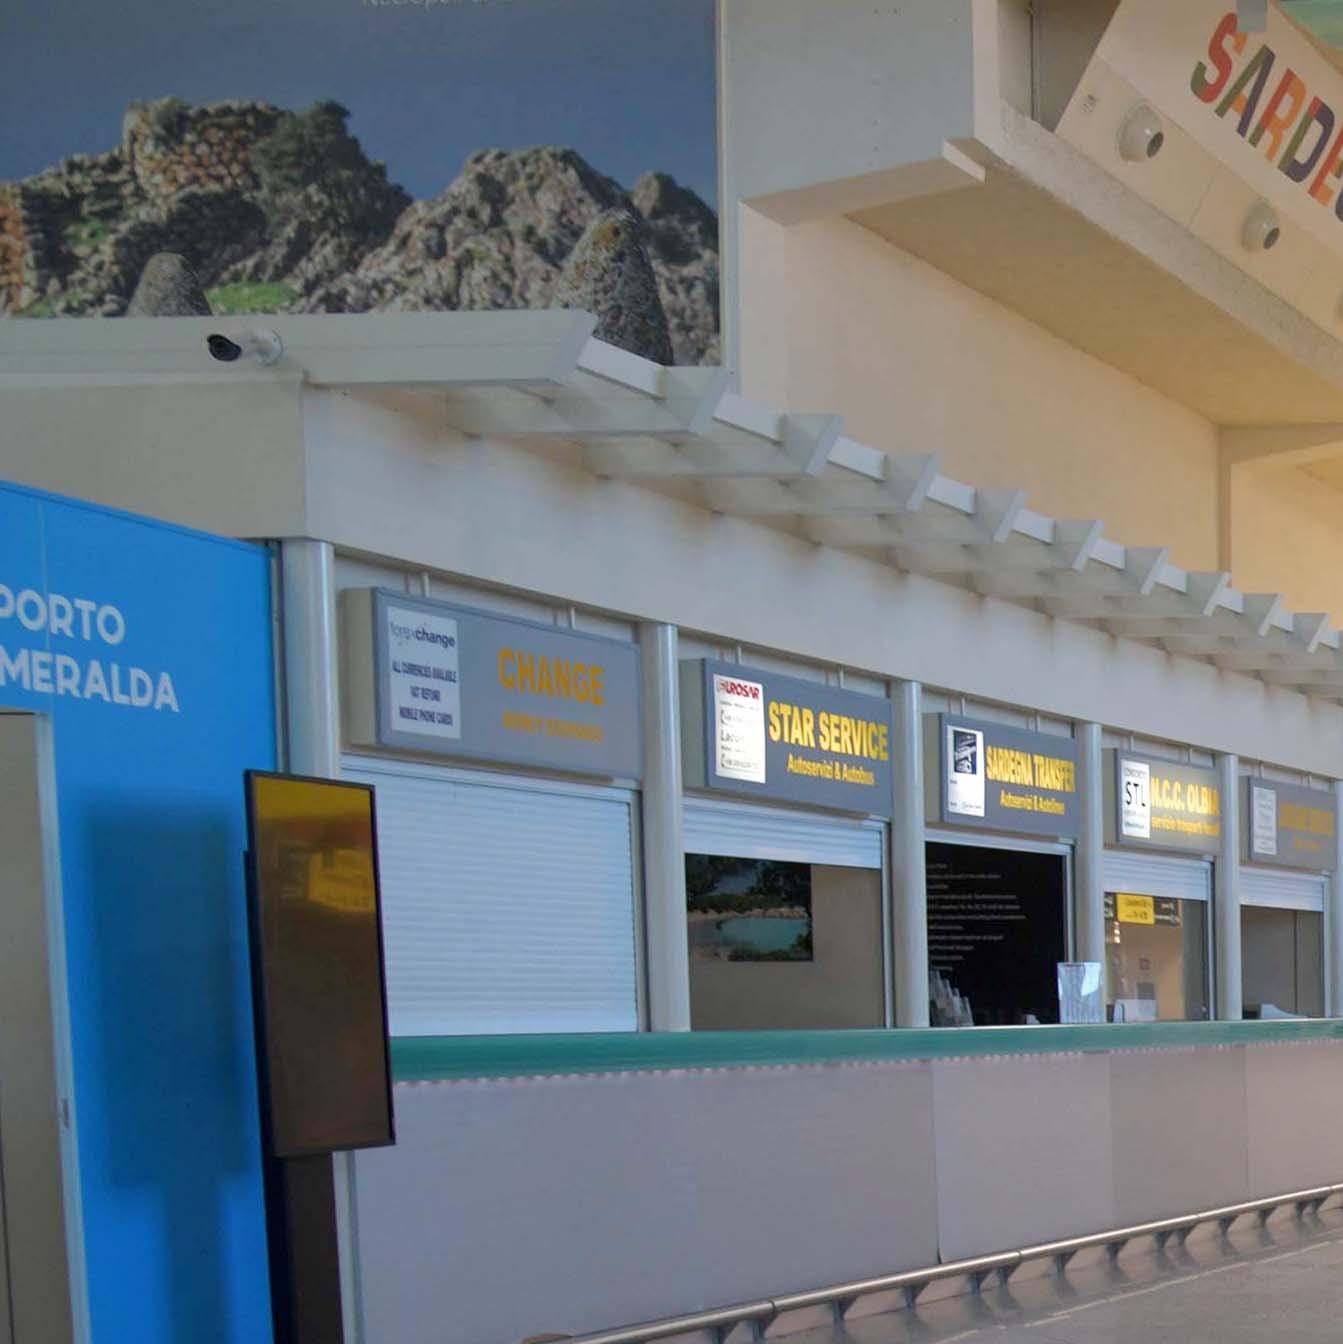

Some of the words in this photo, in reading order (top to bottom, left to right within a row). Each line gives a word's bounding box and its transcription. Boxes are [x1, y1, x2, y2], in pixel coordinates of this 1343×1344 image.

[497, 646, 606, 707] CHANGE
[768, 701, 816, 749] STAR
[818, 710, 889, 762] SERVICE
[986, 745, 1034, 787] SARDEGNA
